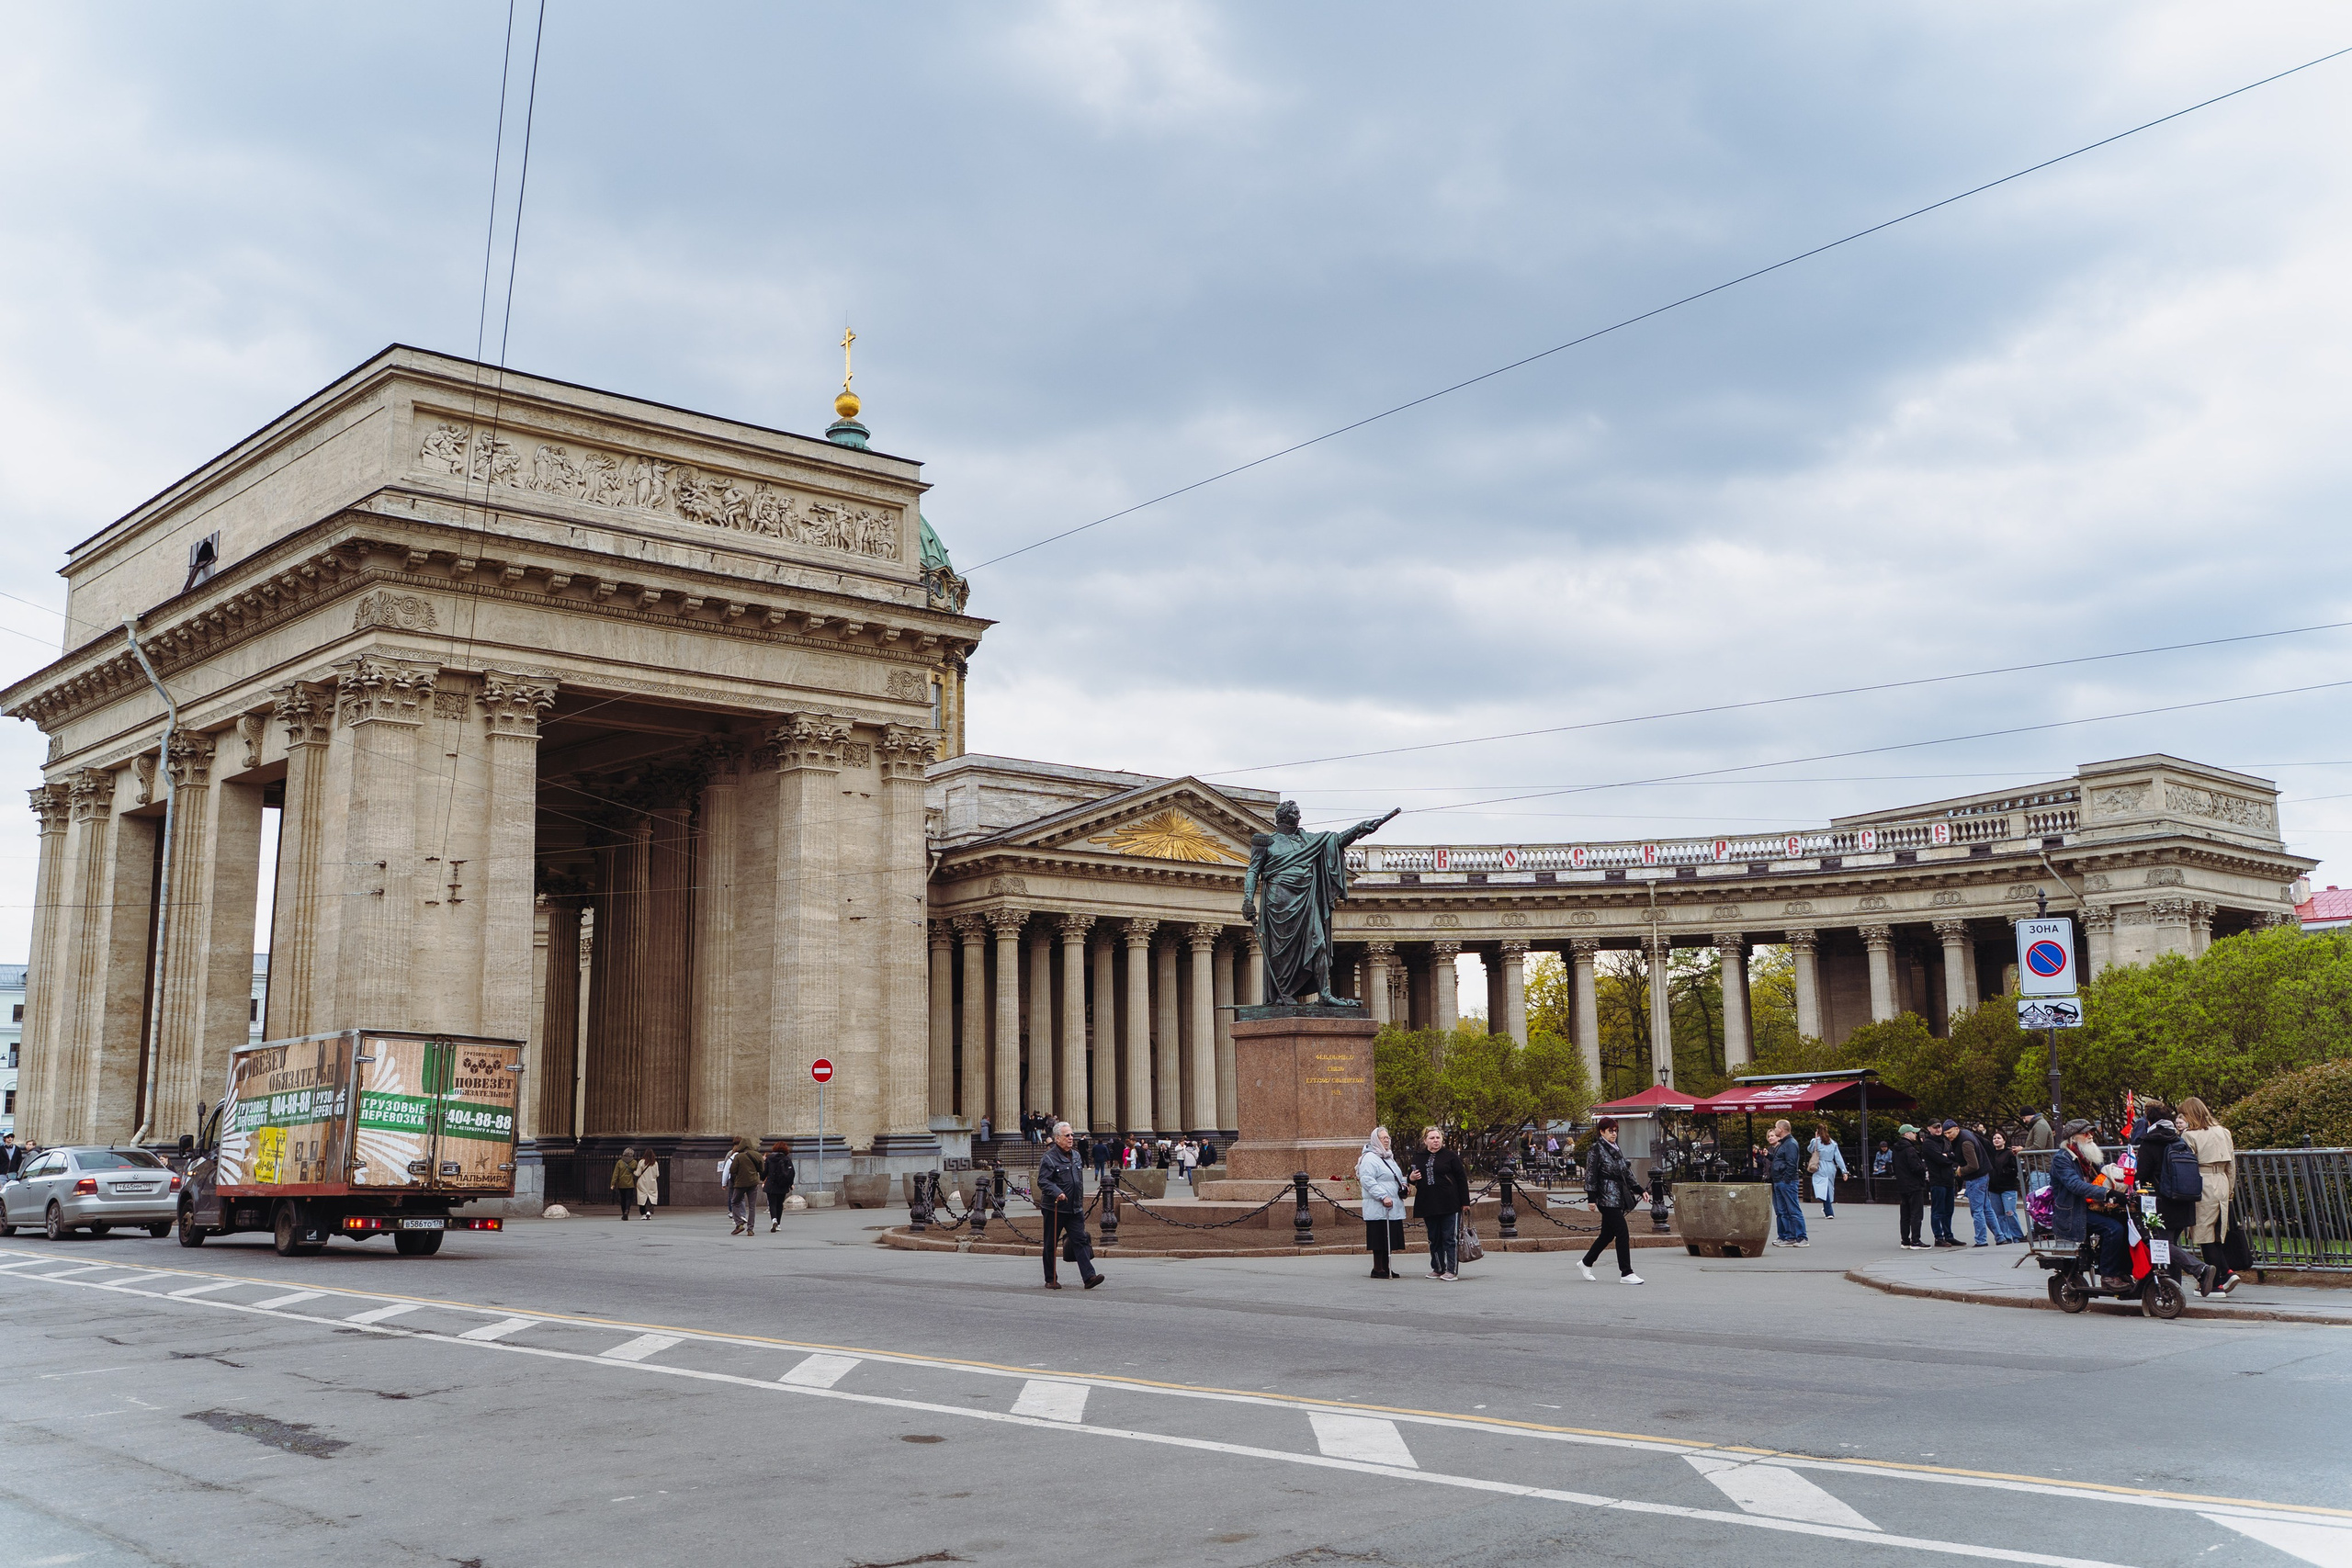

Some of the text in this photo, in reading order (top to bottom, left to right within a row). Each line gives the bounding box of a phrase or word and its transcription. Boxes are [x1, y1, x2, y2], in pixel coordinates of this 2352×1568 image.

[2029, 924, 2059, 933] ЗОНА
[455, 1077, 513, 1089] ПОВЕЗЁТ
[455, 1089, 511, 1099] ОБЯЗАТЕЛЬНО!
[271, 1091, 311, 1116] 404-88-88
[362, 1098, 426, 1115] ГРУЗОВЫЕ
[361, 1109, 424, 1125] ПЕРЕВОЗКИ
[447, 1109, 513, 1130] 404-88-88
[456, 1174, 507, 1183] ПАЛЬМИРА
